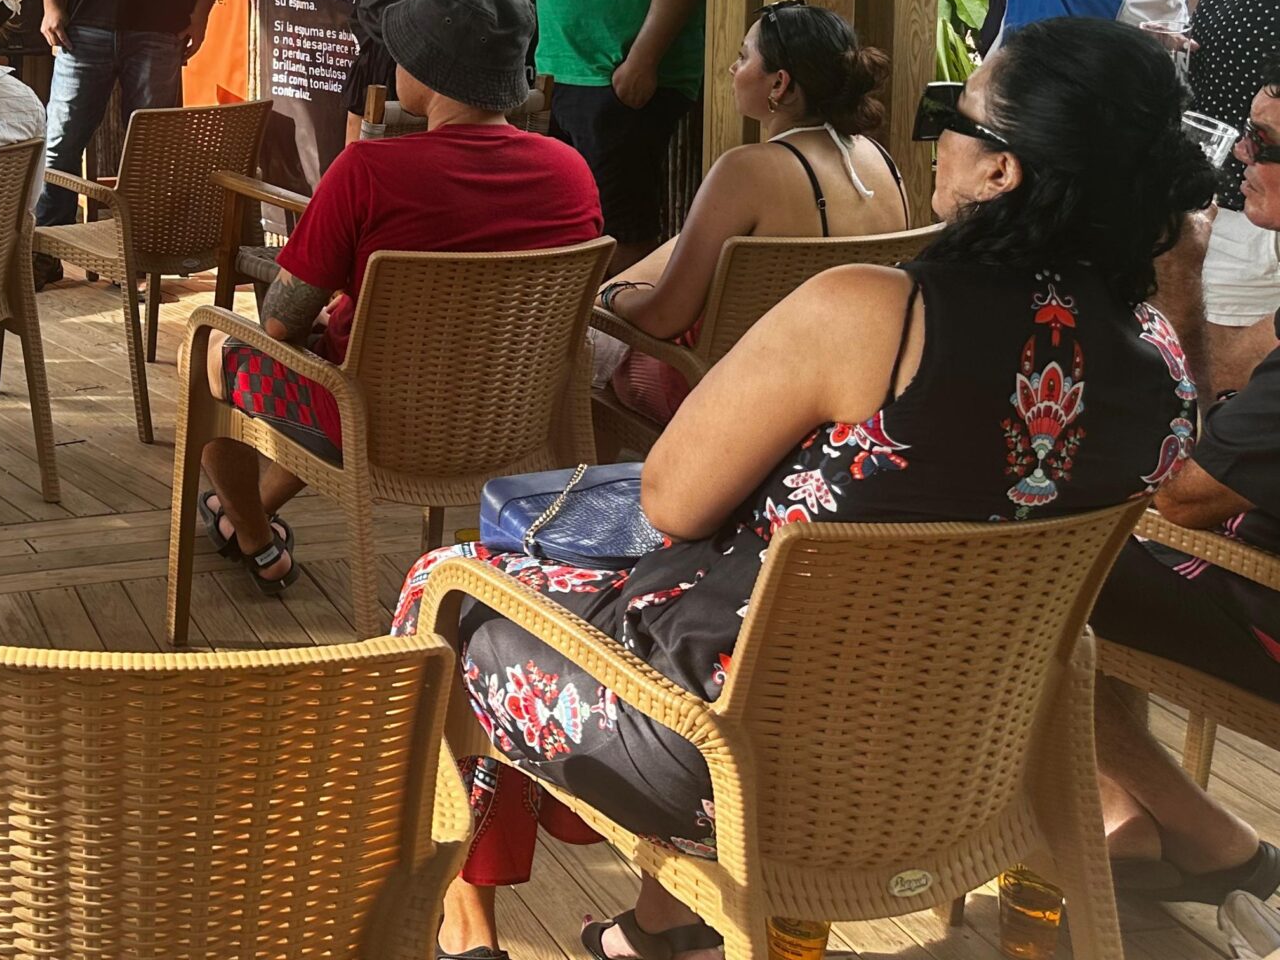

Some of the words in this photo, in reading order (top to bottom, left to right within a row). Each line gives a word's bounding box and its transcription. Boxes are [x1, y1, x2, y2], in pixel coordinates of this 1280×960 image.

[286, 22, 293, 32] la
[326, 30, 336, 39] es
[274, 36, 279, 44] o
[302, 38, 348, 54] desaparece
[273, 48, 279, 56] o
[326, 54, 334, 65] la
[272, 72, 286, 83] así
[309, 66, 346, 80] nebulosa
